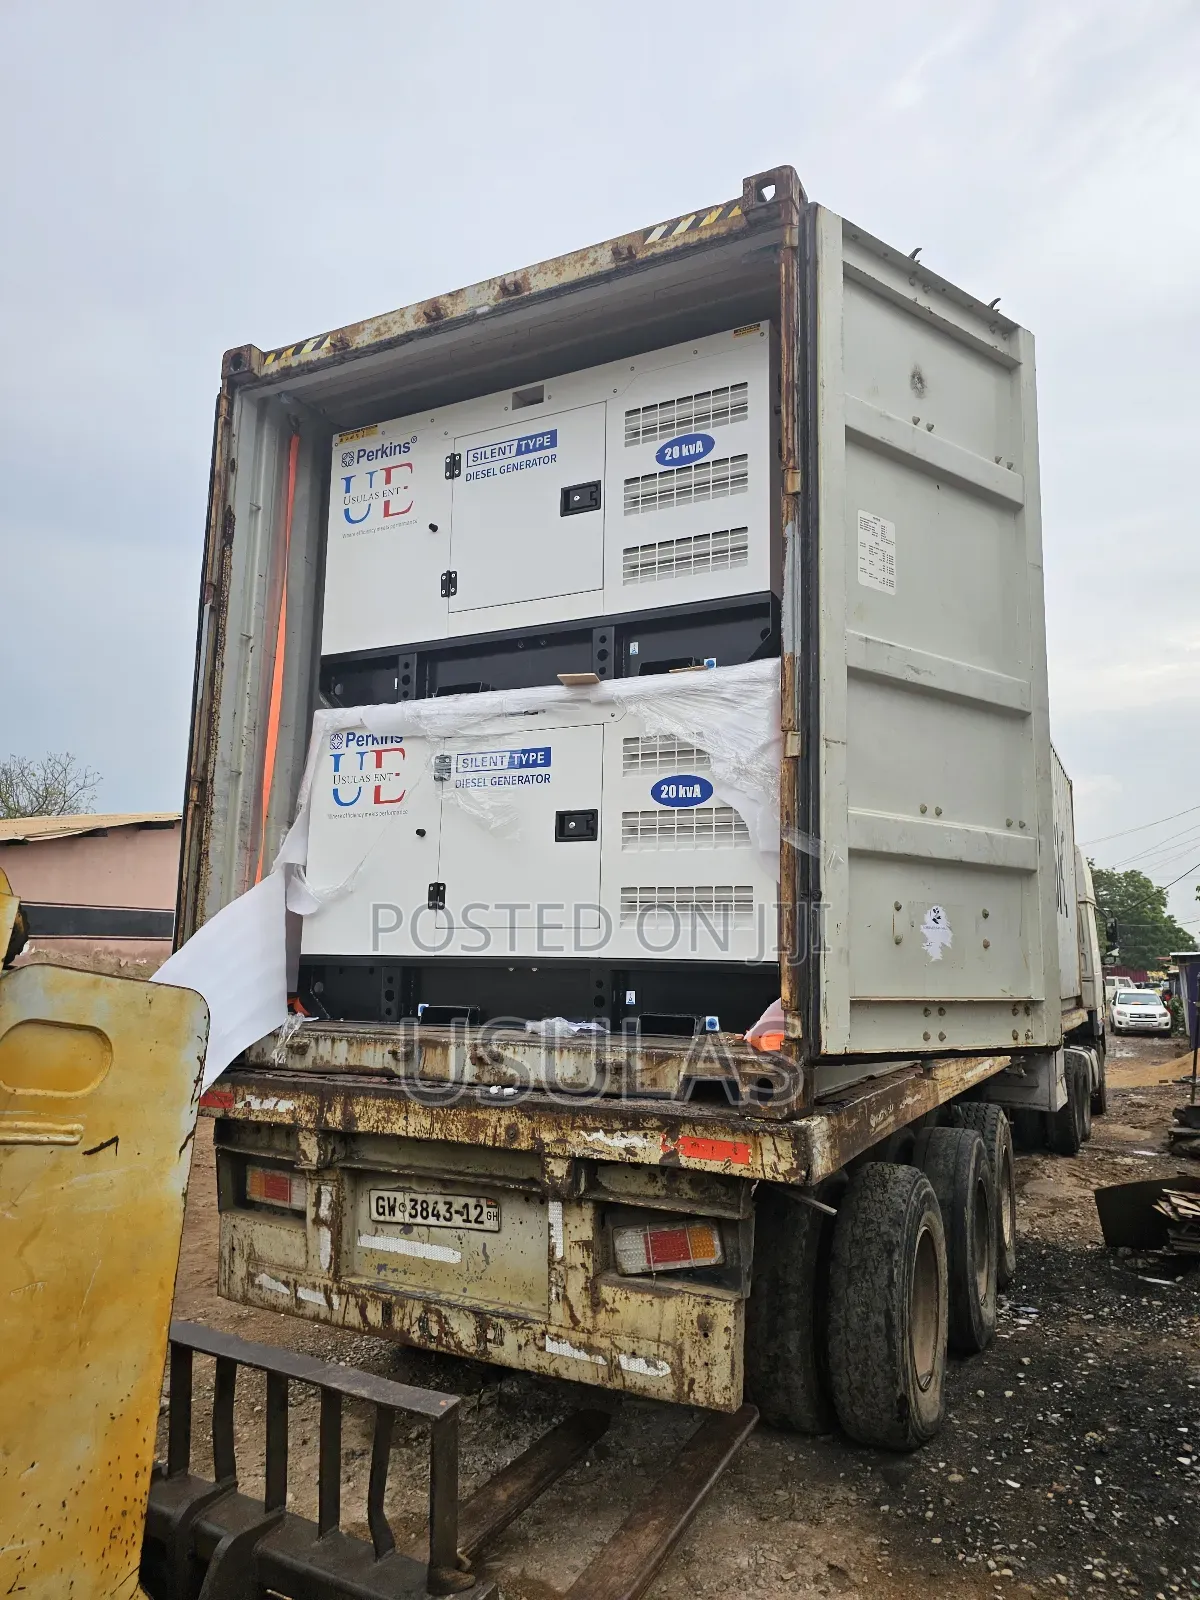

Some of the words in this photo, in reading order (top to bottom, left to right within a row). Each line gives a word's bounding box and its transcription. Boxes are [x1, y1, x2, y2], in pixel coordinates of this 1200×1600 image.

[471, 443, 515, 463] SILENT
[519, 434, 551, 452] TYPE
[664, 445, 680, 460] 20
[465, 467, 498, 482] DIESEL
[499, 453, 557, 475] GENERATOR
[343, 491, 380, 506] USULAS
[382, 486, 401, 498] ENT
[345, 731, 404, 748] Perkins
[461, 754, 507, 769] SILENT
[511, 751, 545, 765] TYPE
[333, 773, 371, 786] USULAS
[373, 772, 394, 782] ENT
[455, 777, 489, 789] DIESEL
[490, 773, 551, 786] GENERATOR
[660, 784, 677, 799] 20
[375, 1195, 397, 1217] GW
[408, 1198, 485, 1225] 3843-12
[486, 1210, 498, 1222] GH
